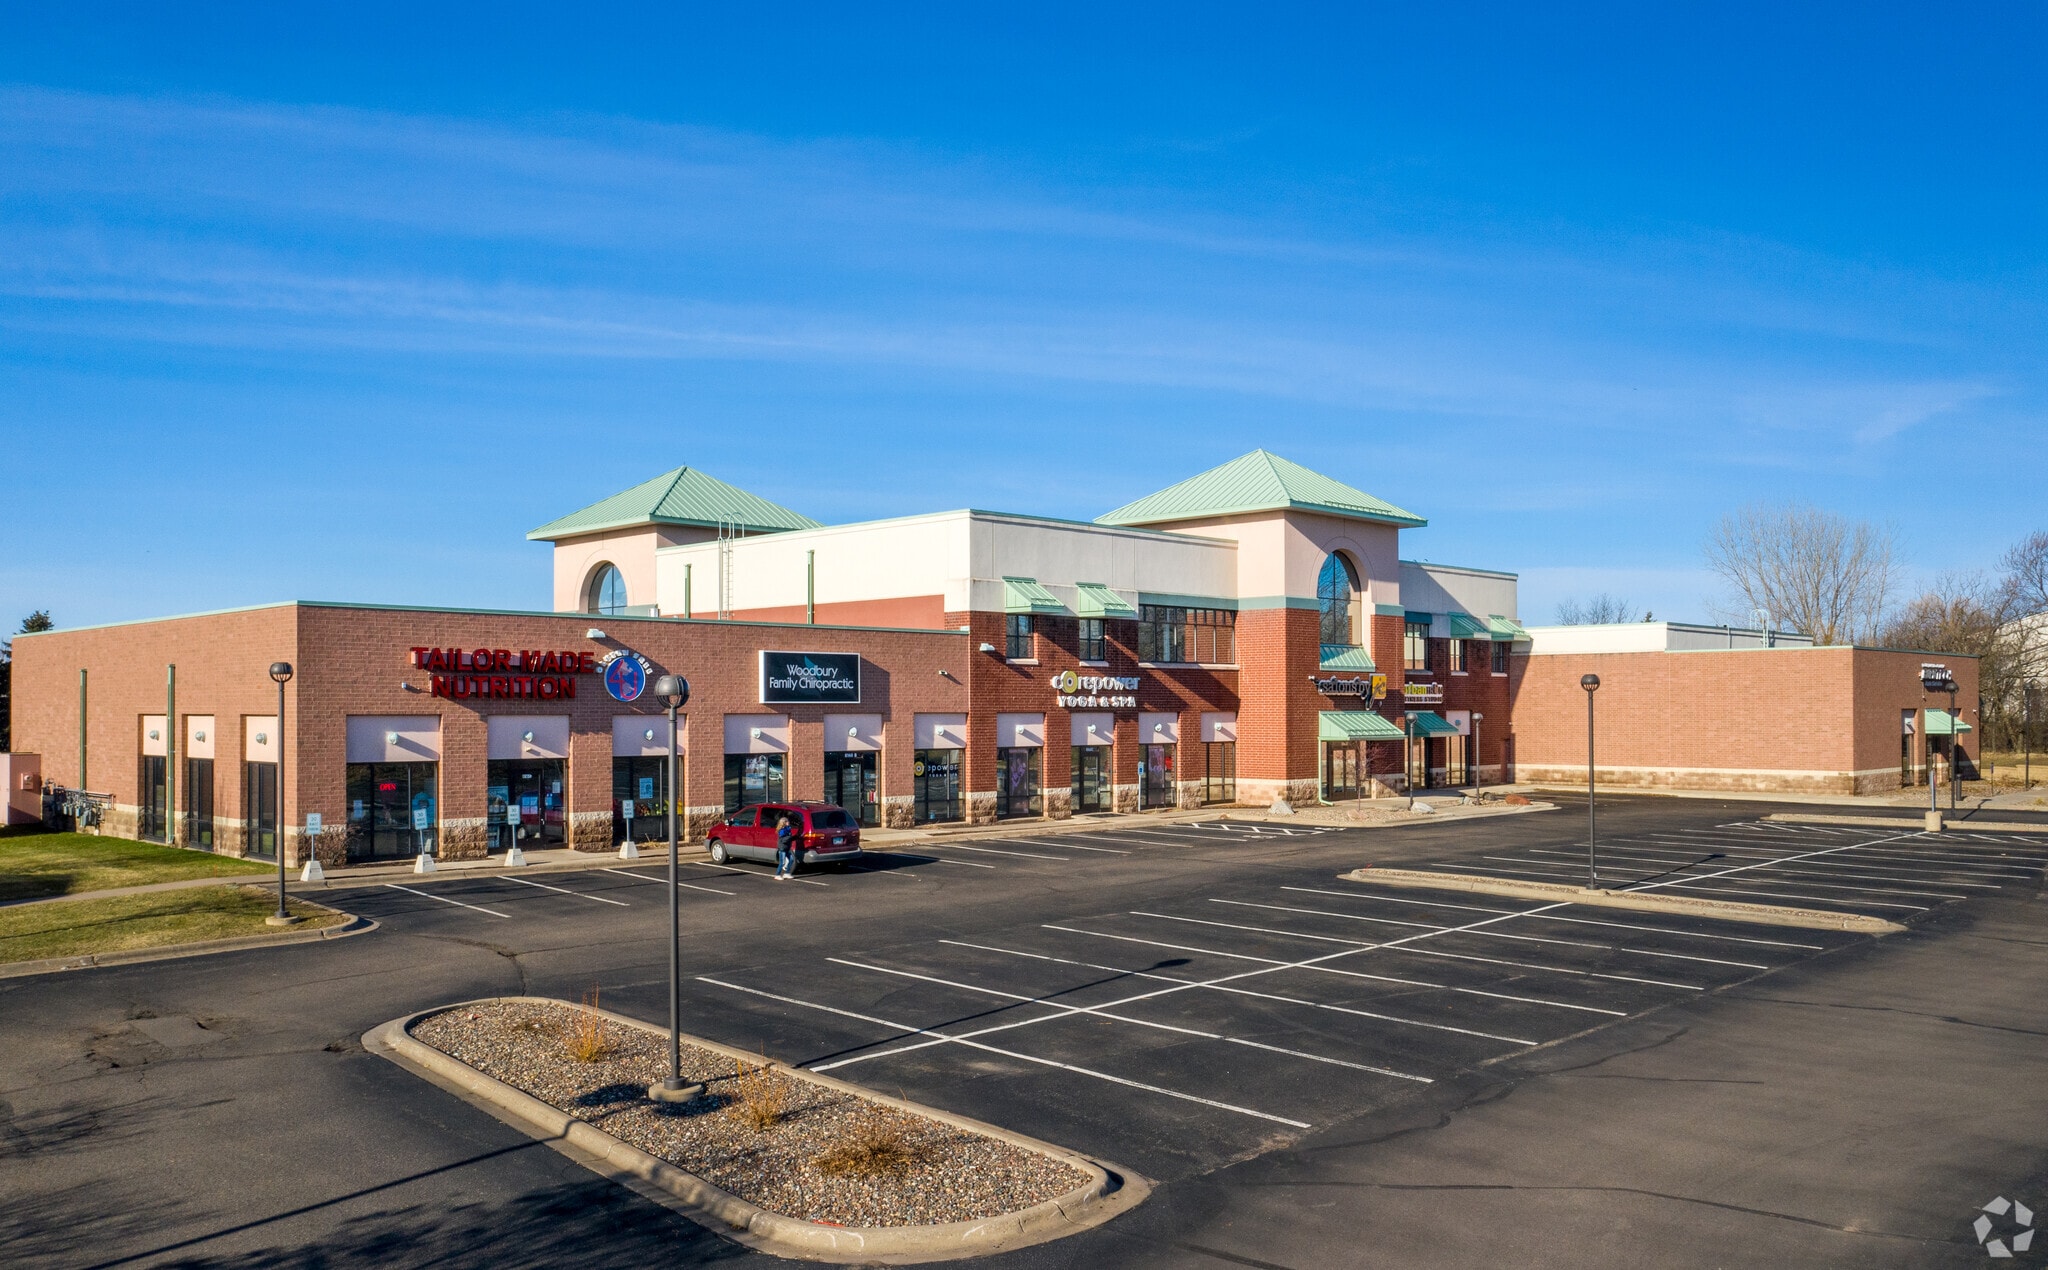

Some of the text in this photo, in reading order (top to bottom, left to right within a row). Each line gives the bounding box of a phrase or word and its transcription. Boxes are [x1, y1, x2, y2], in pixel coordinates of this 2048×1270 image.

[410, 646, 512, 672] TAILOR
[520, 649, 595, 674] MADE
[786, 664, 838, 679] Woodbury
[430, 675, 576, 699] NUTRITION
[769, 677, 854, 691] Family Chiropractic
[1051, 670, 1140, 694] corepower
[1321, 679, 1357, 693] salons
[1057, 695, 1136, 708] YOGA & SPA
[379, 783, 397, 791] OPEN
